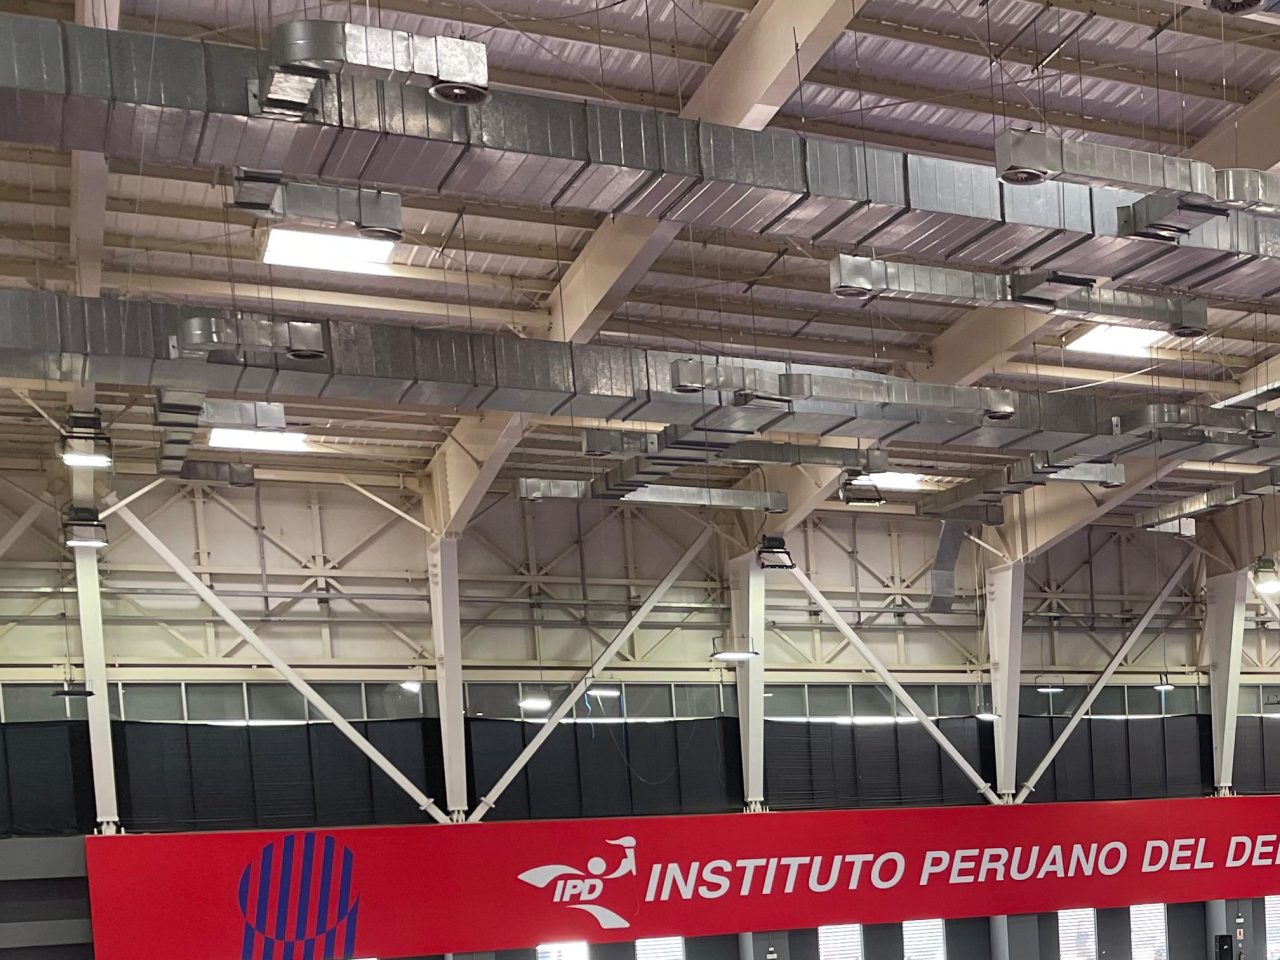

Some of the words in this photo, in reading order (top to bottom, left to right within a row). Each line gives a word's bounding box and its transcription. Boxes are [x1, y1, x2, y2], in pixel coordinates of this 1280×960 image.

[553, 878, 604, 902] IPD
[645, 851, 906, 902] INSTITUTO
[919, 841, 1128, 886] PERUANO
[1141, 838, 1215, 873] DEL
